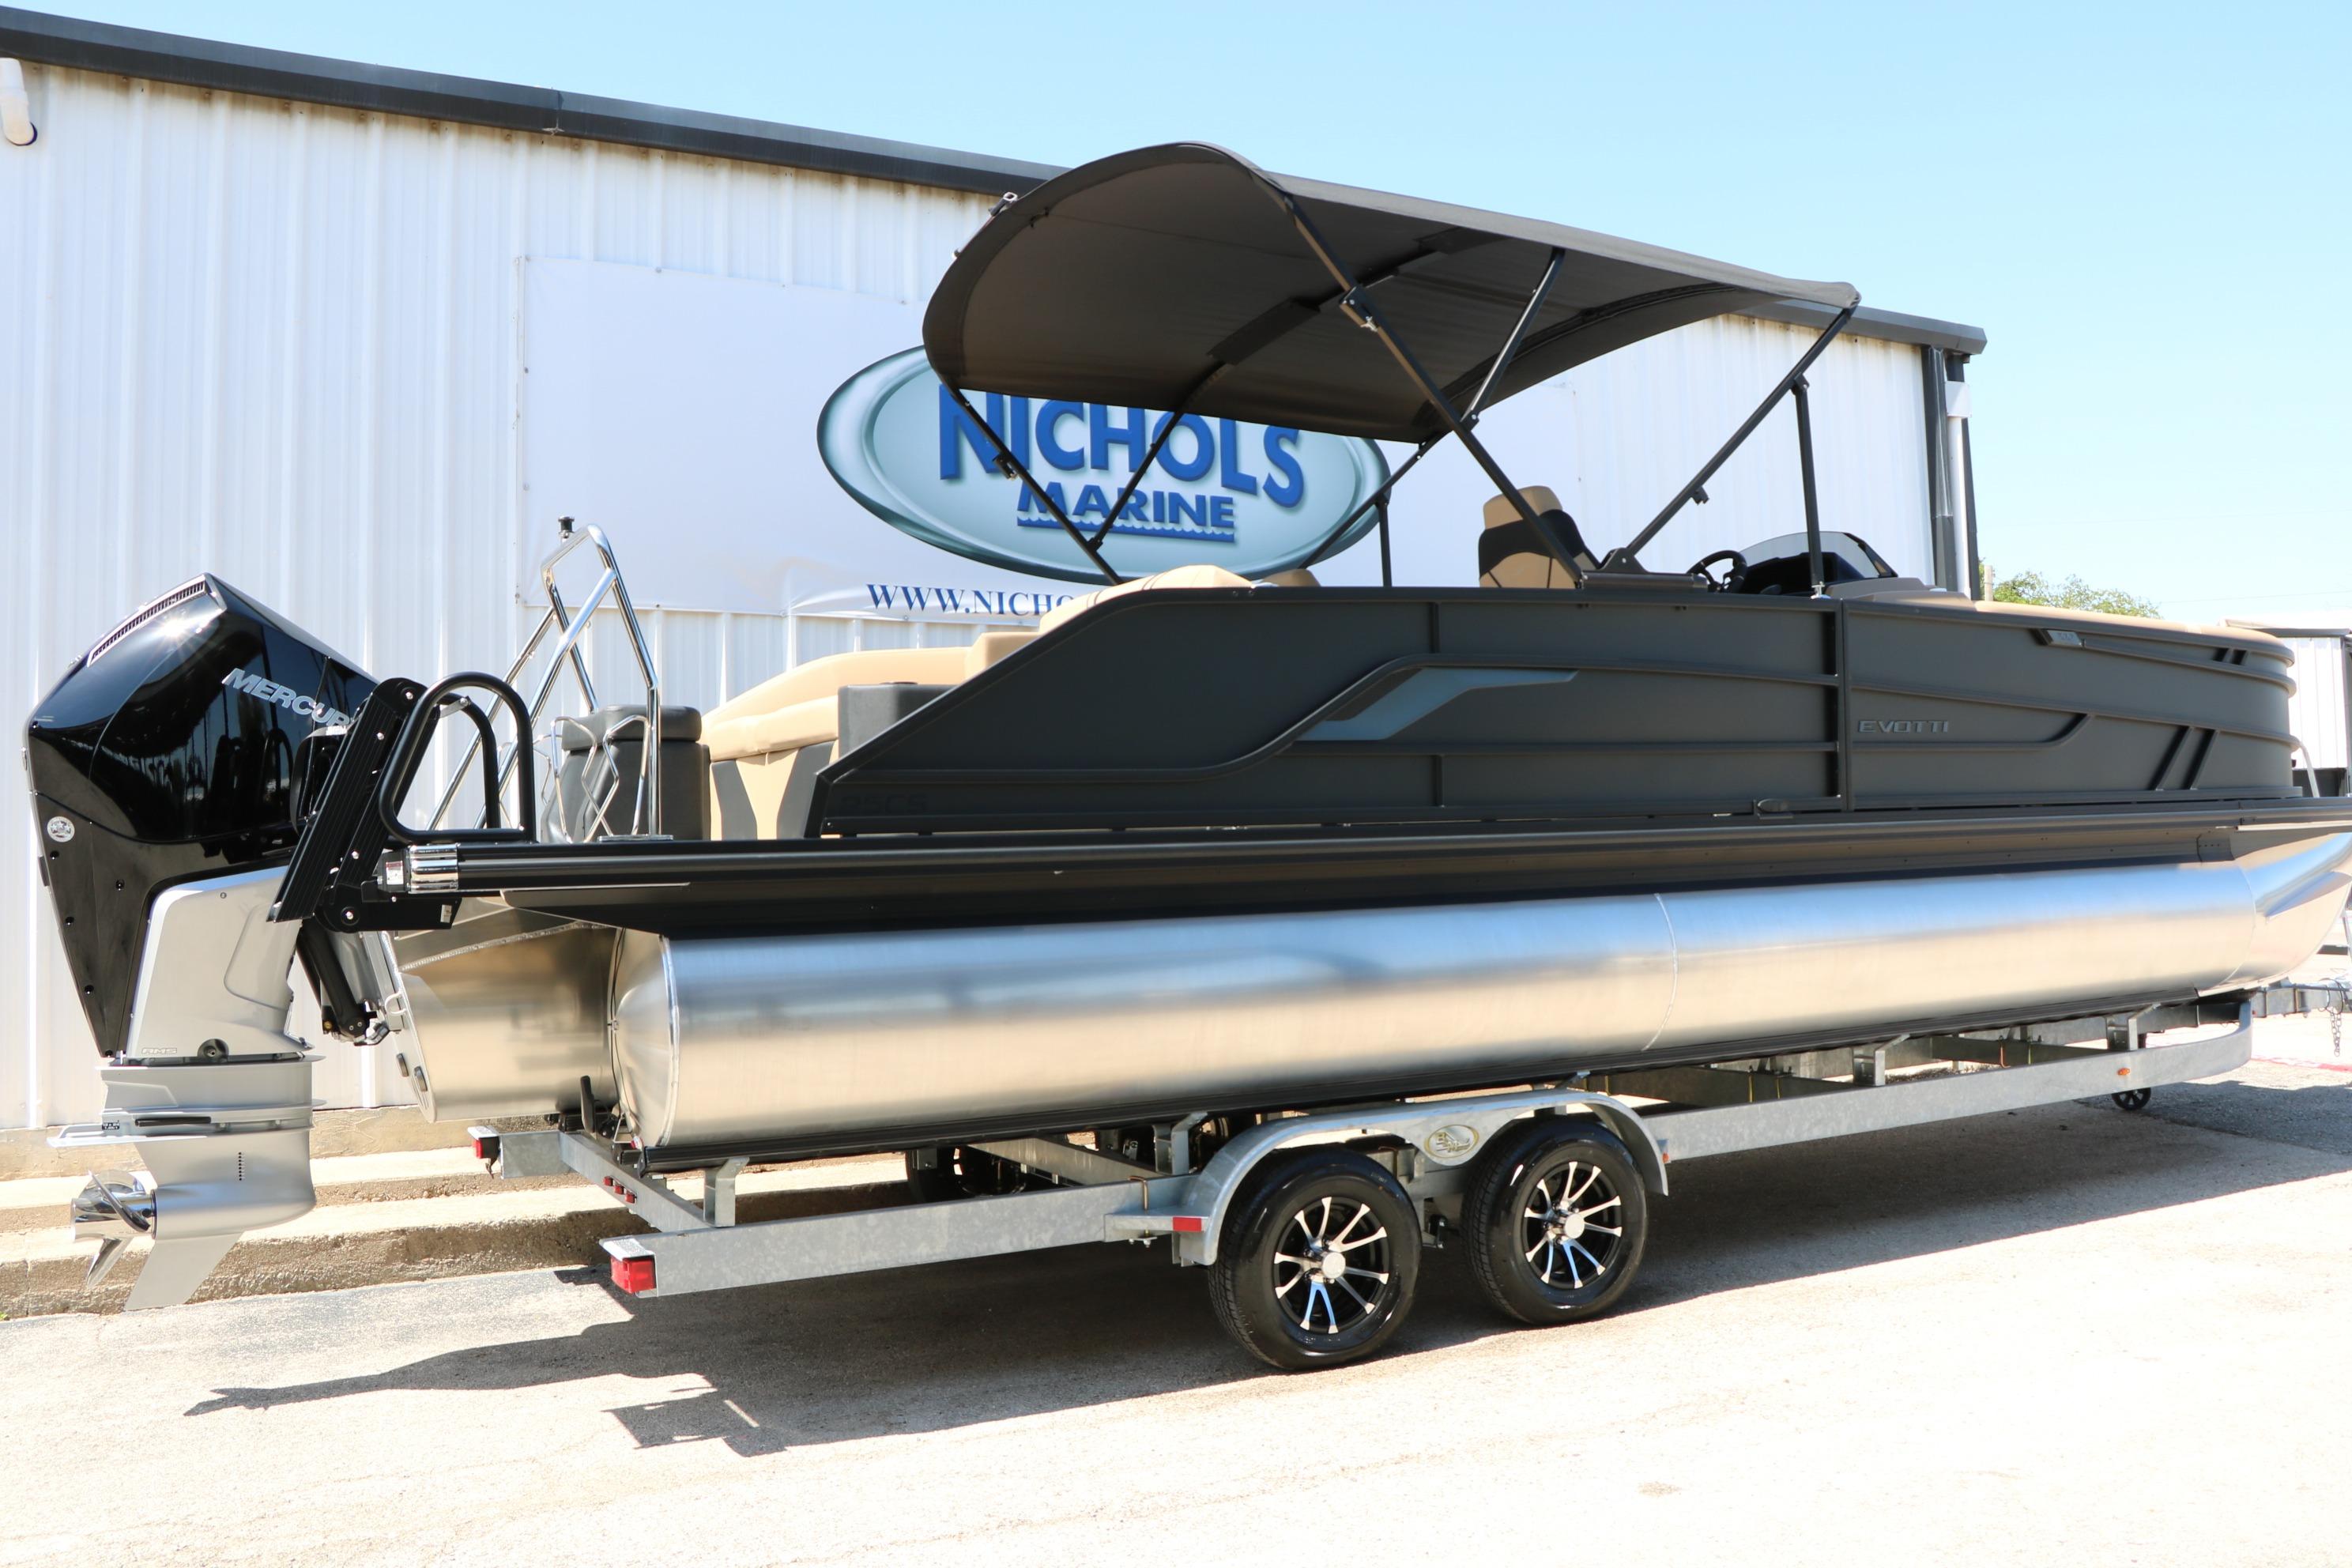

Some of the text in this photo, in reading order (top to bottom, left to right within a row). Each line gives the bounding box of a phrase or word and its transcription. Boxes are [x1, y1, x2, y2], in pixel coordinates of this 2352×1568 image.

[938, 383, 1305, 508] NICHOLS
[1016, 480, 1234, 528] MARINE
[221, 667, 356, 727] MERCUR
[1857, 719, 1950, 733] EVOTTI
